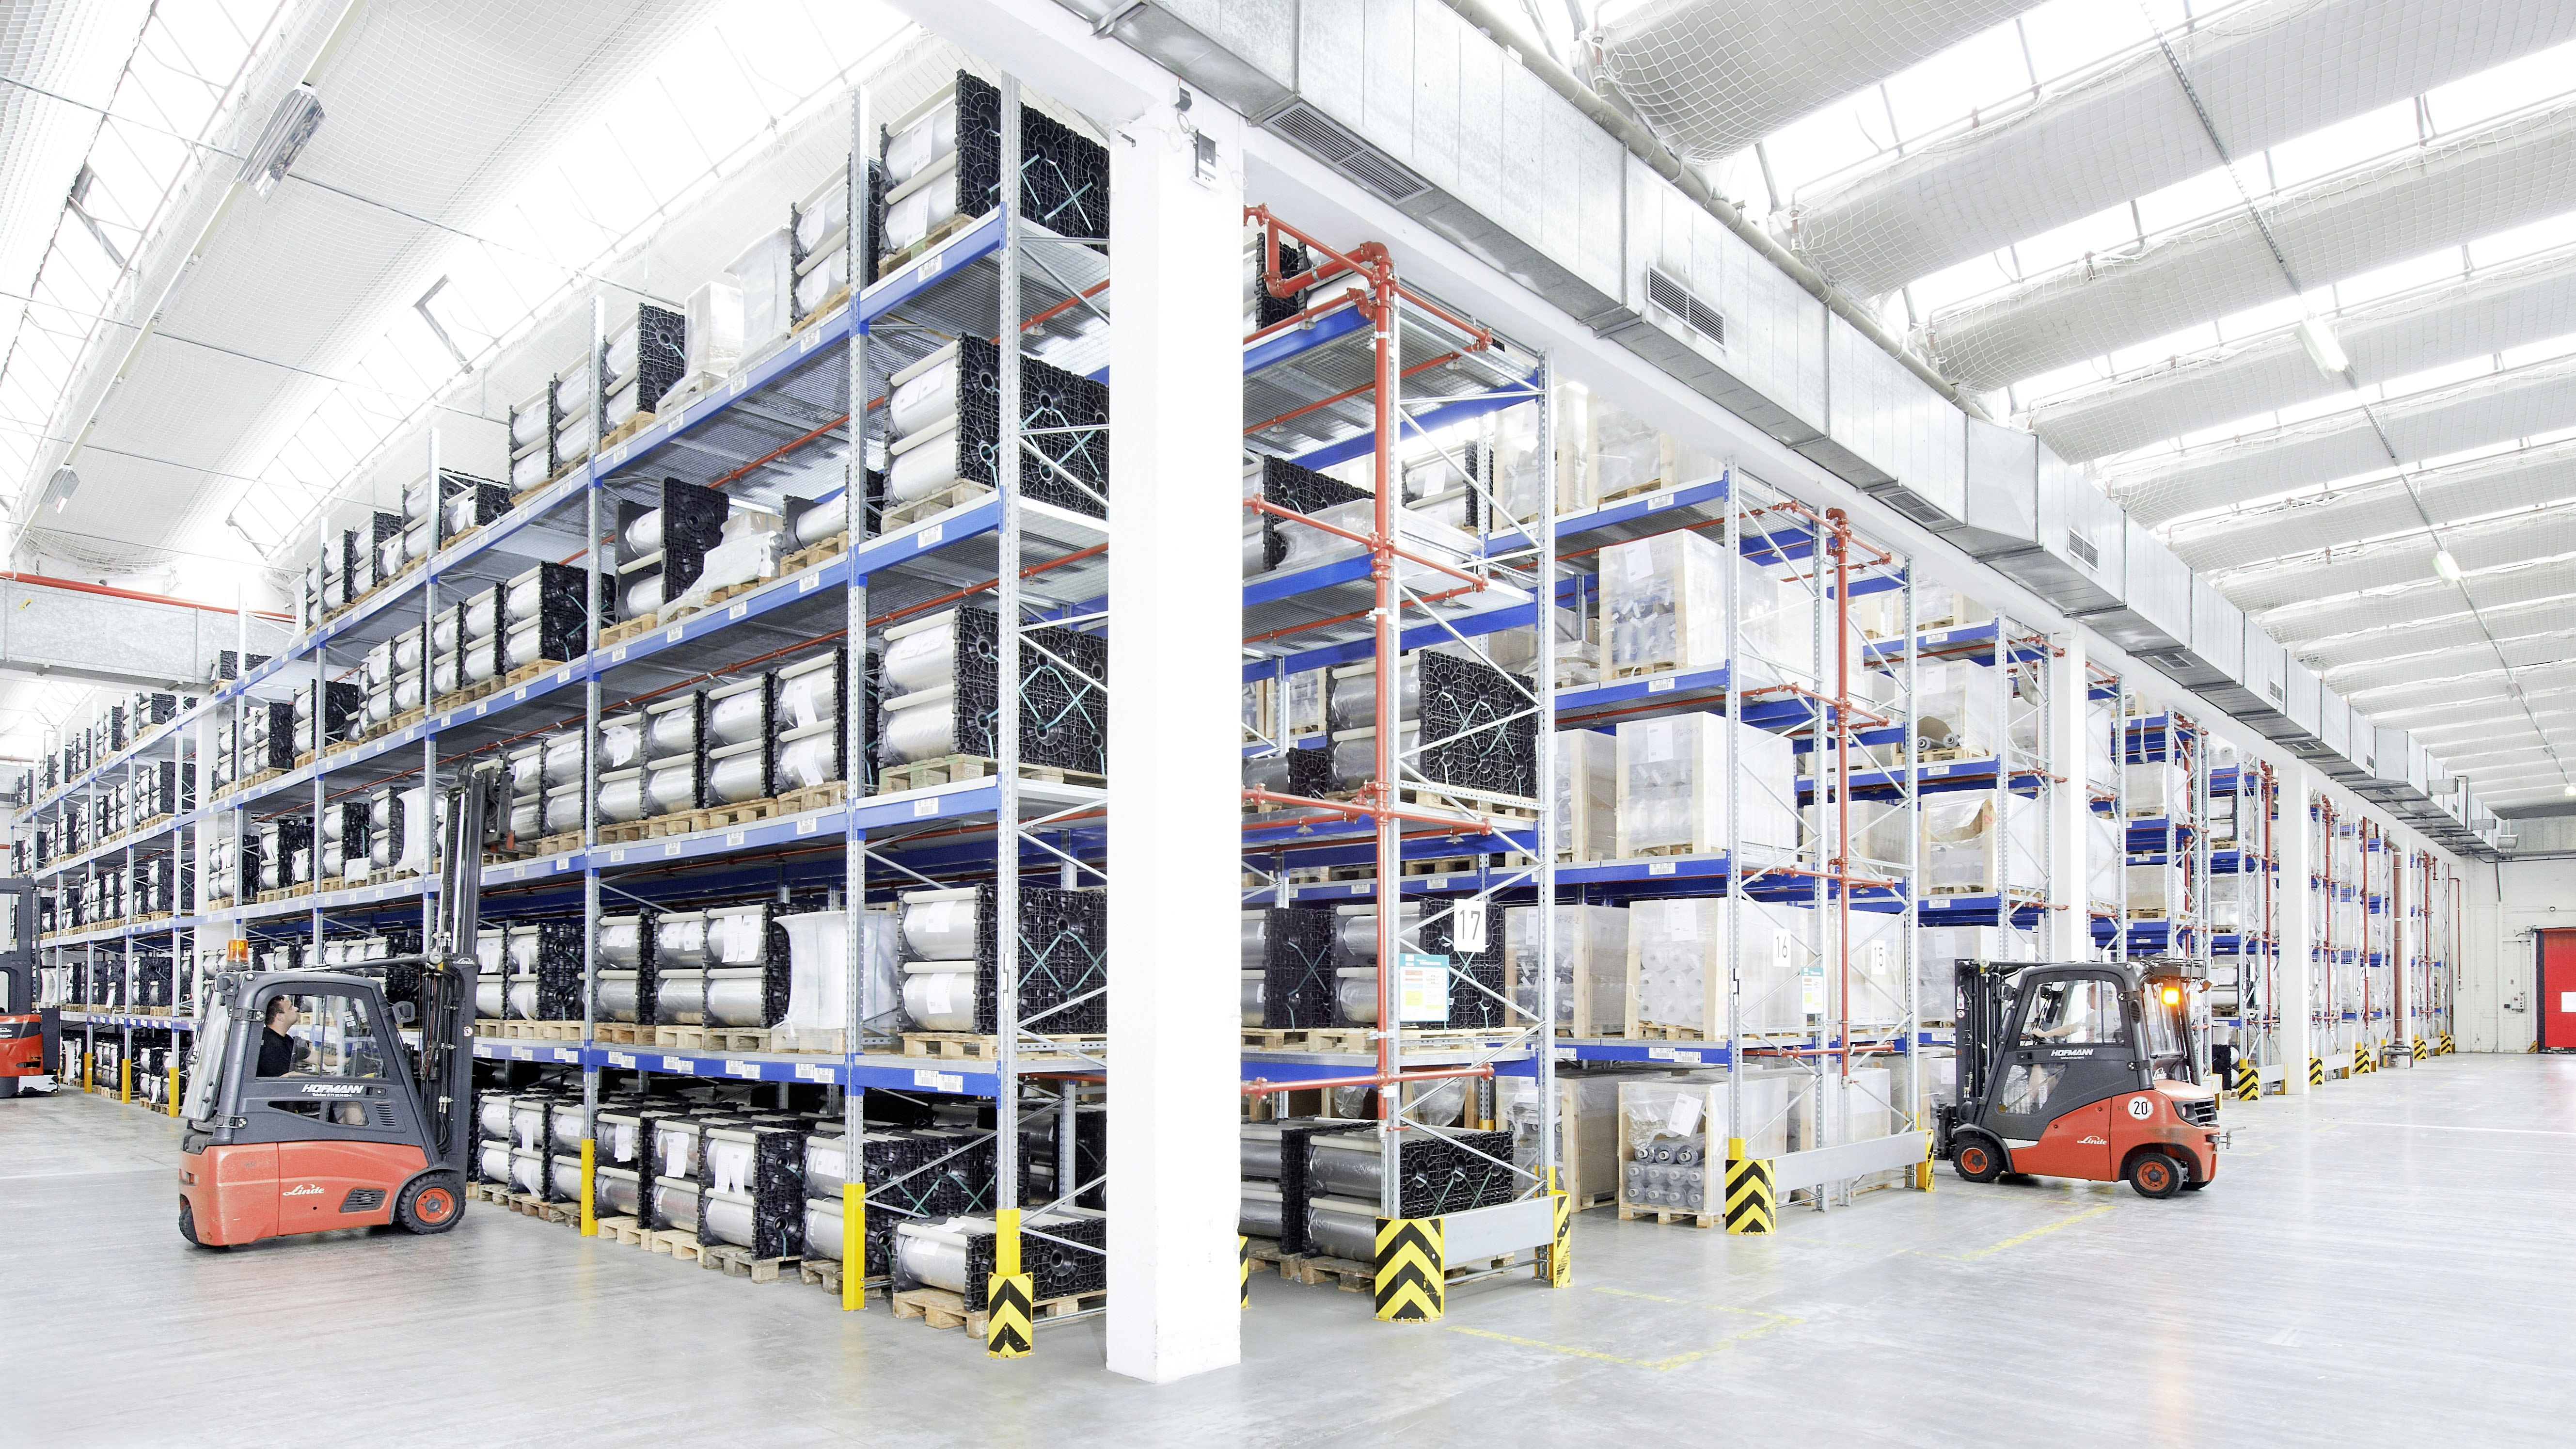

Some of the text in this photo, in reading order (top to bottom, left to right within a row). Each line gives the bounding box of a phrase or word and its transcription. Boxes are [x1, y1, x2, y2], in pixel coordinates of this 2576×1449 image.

[1459, 909, 1481, 939] 17
[1776, 936, 1788, 958] 16
[1874, 947, 1884, 967] 15
[2152, 1067, 2167, 1080] Linde
[301, 1084, 364, 1094] HOFMANN
[2134, 1101, 2148, 1115] 20
[2077, 1135, 2107, 1145] Linde
[283, 1183, 325, 1196] Linde
